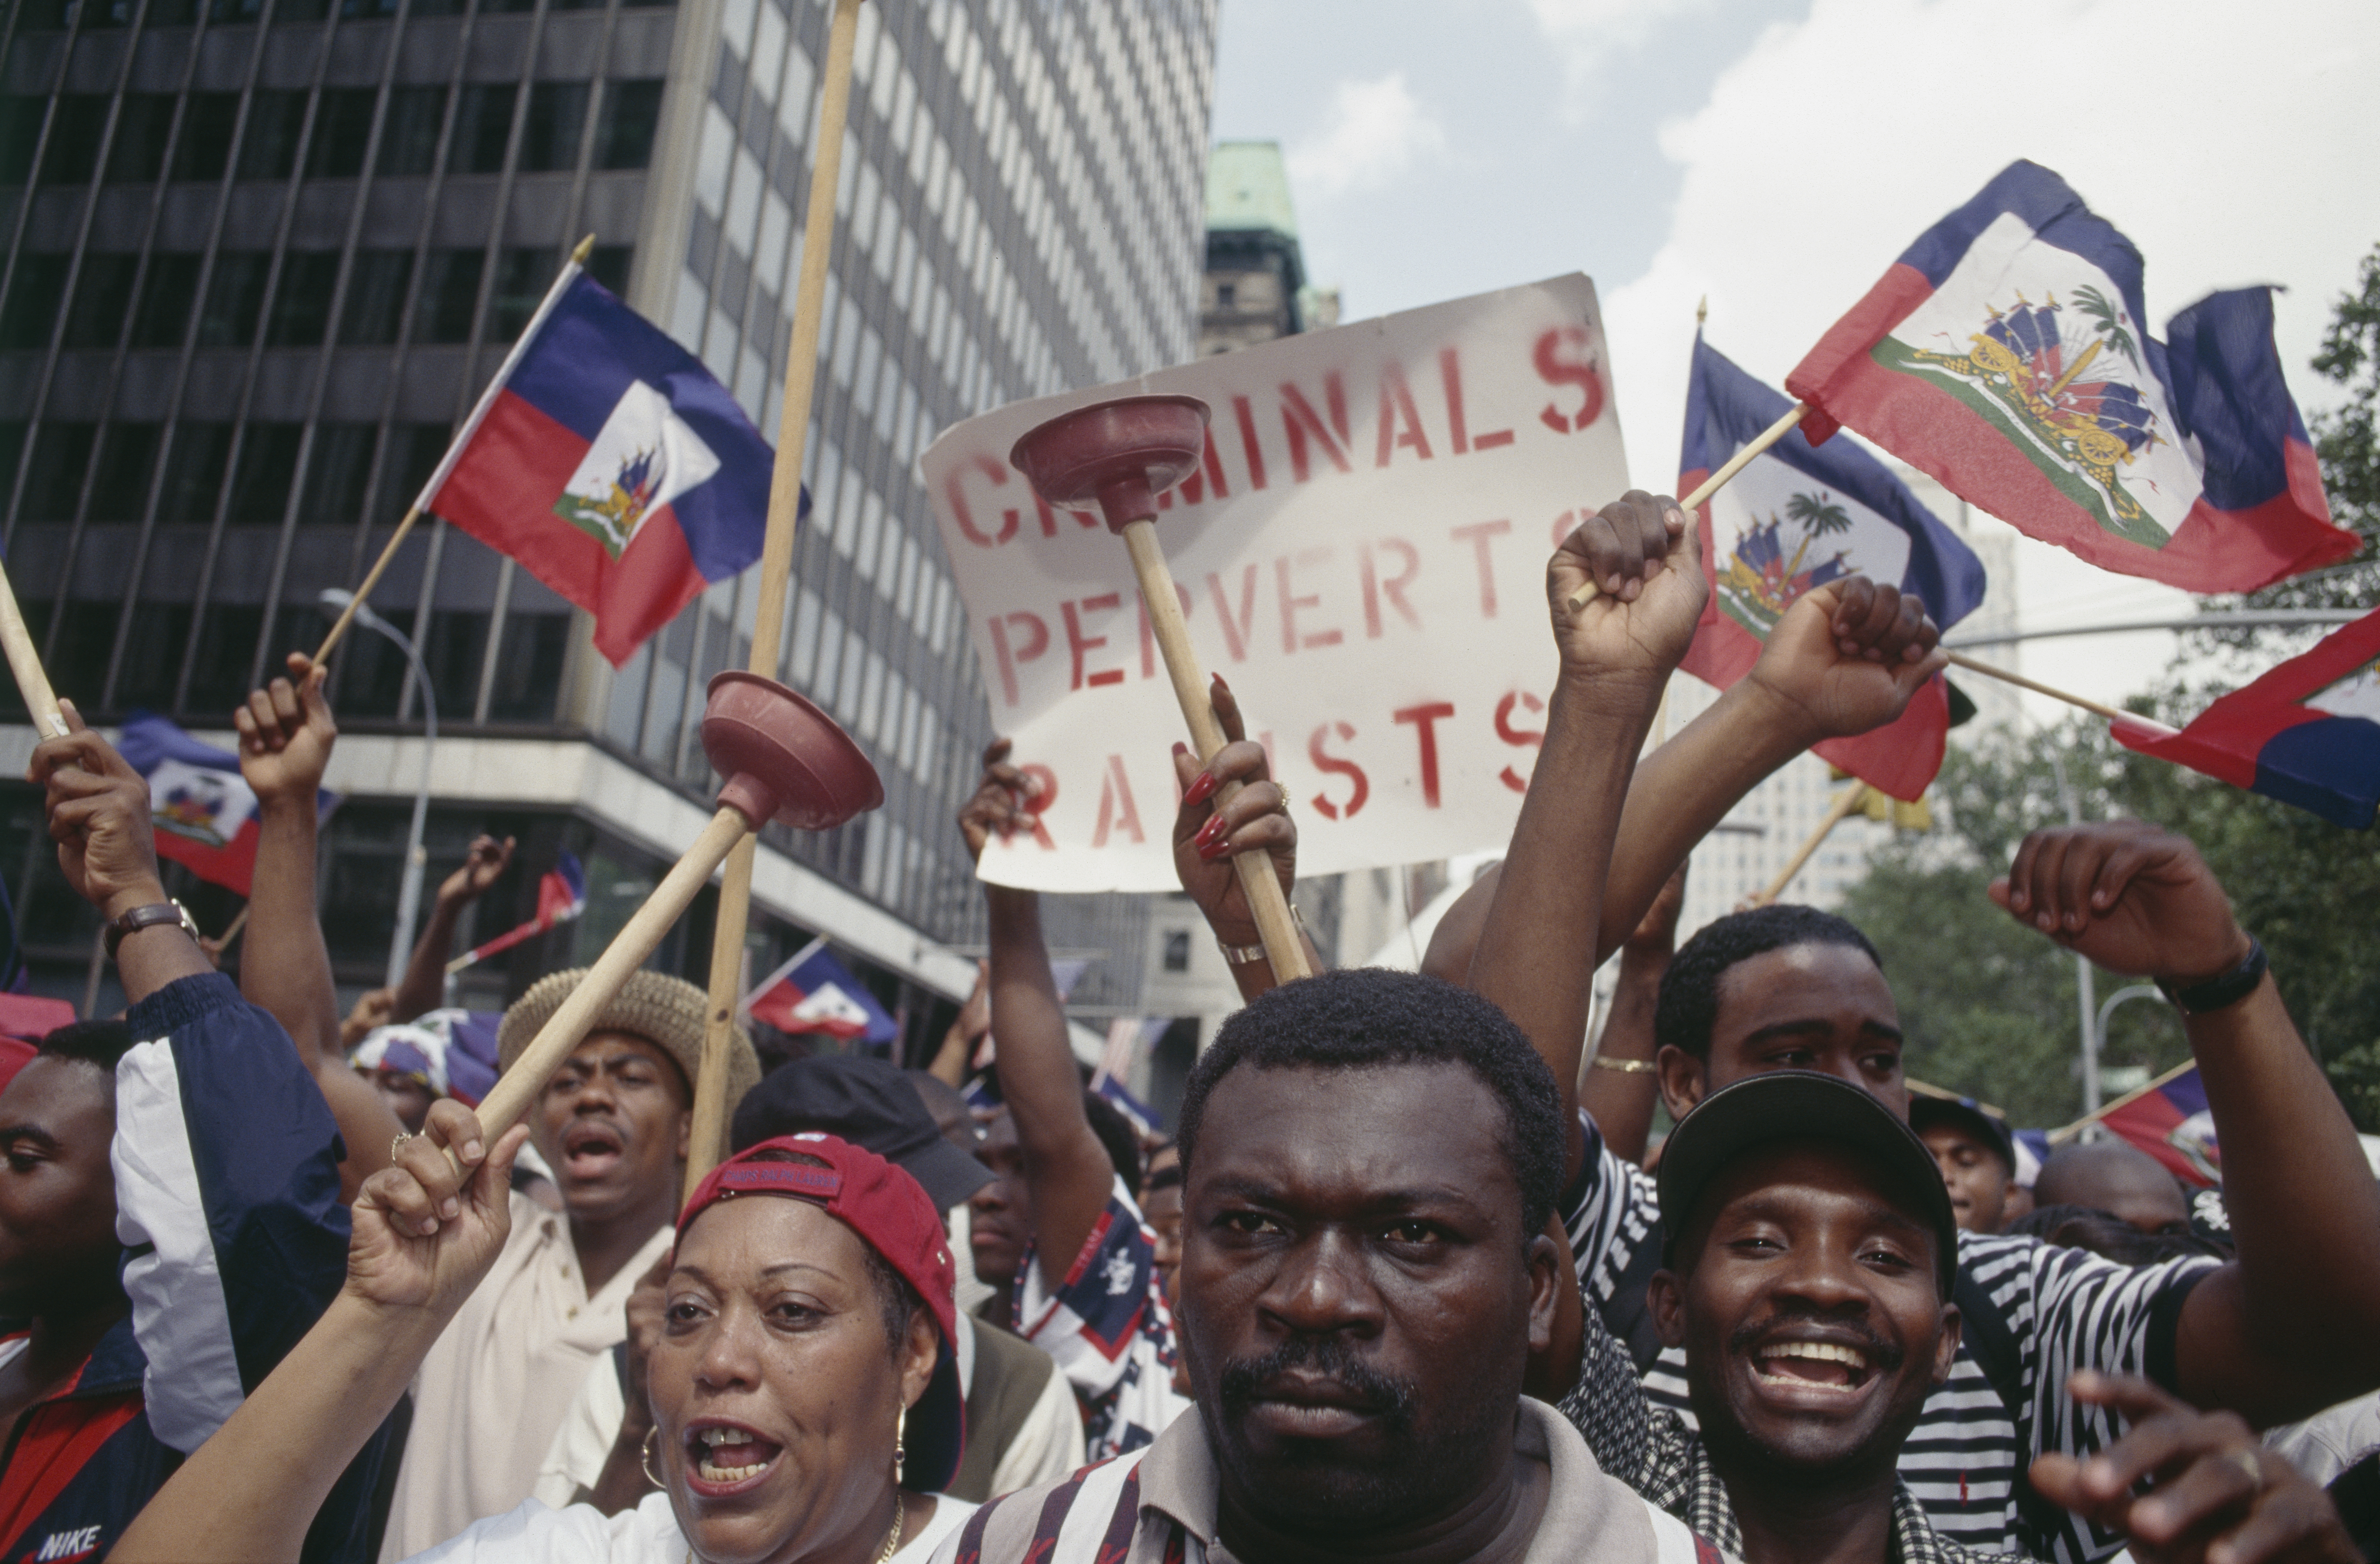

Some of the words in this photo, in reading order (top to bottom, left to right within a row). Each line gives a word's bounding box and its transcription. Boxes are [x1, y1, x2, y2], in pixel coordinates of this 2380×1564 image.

[943, 324, 1609, 549] CMINALS
[998, 690, 1546, 850] RASTS
[724, 1169, 758, 1182] CHAPS
[760, 1169, 795, 1182] RALPH
[796, 1171, 838, 1187] LAUREN
[38, 1525, 102, 1562] NIKE
